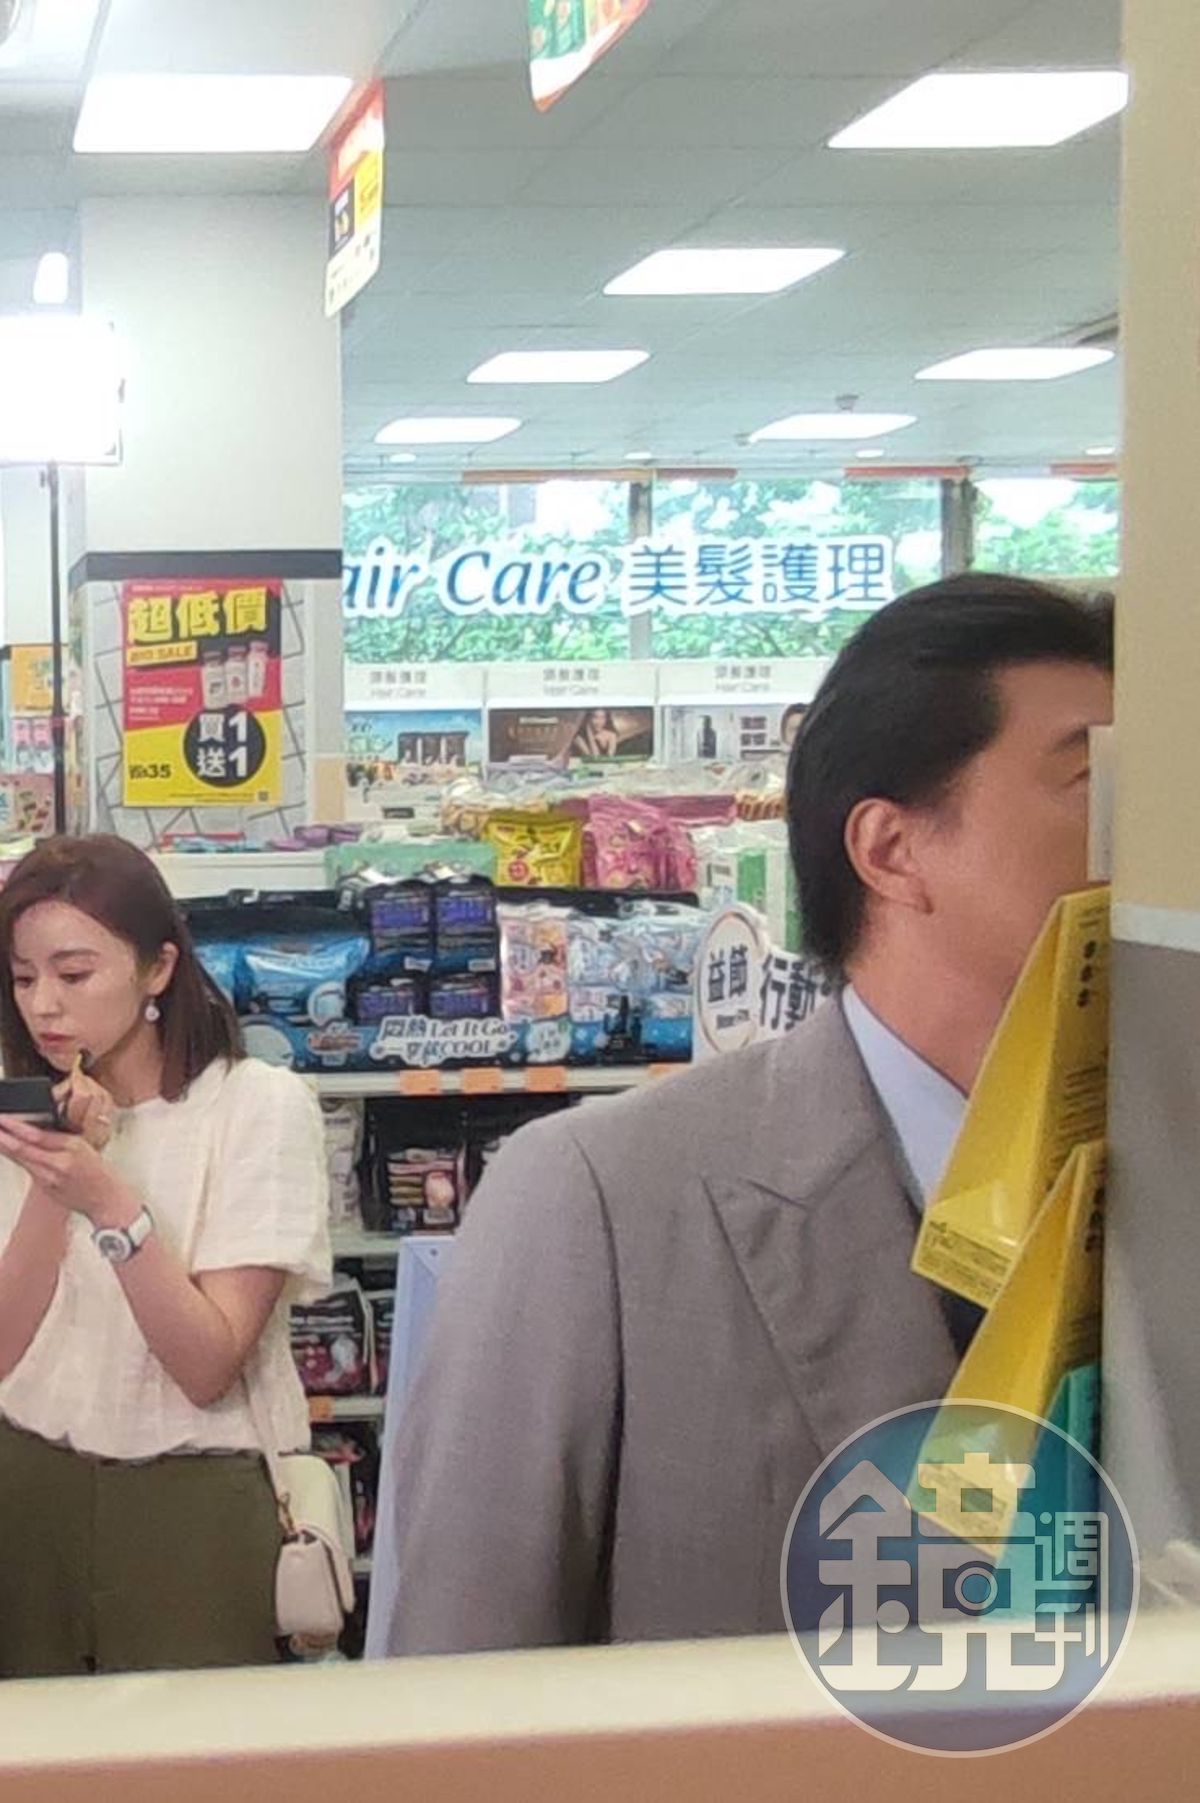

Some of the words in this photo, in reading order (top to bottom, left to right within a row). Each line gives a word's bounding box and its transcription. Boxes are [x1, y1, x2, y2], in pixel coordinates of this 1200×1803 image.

[446, 549, 601, 607] Care
[630, 543, 887, 605] 美髮護理
[128, 588, 267, 643] 超低價
[157, 644, 193, 660] SALE
[199, 711, 248, 743] 買1
[197, 746, 248, 777] 送1
[760, 953, 832, 1031] 行動
[430, 1021, 457, 1037] Let
[464, 1021, 478, 1037] It
[441, 1040, 491, 1056] COOL
